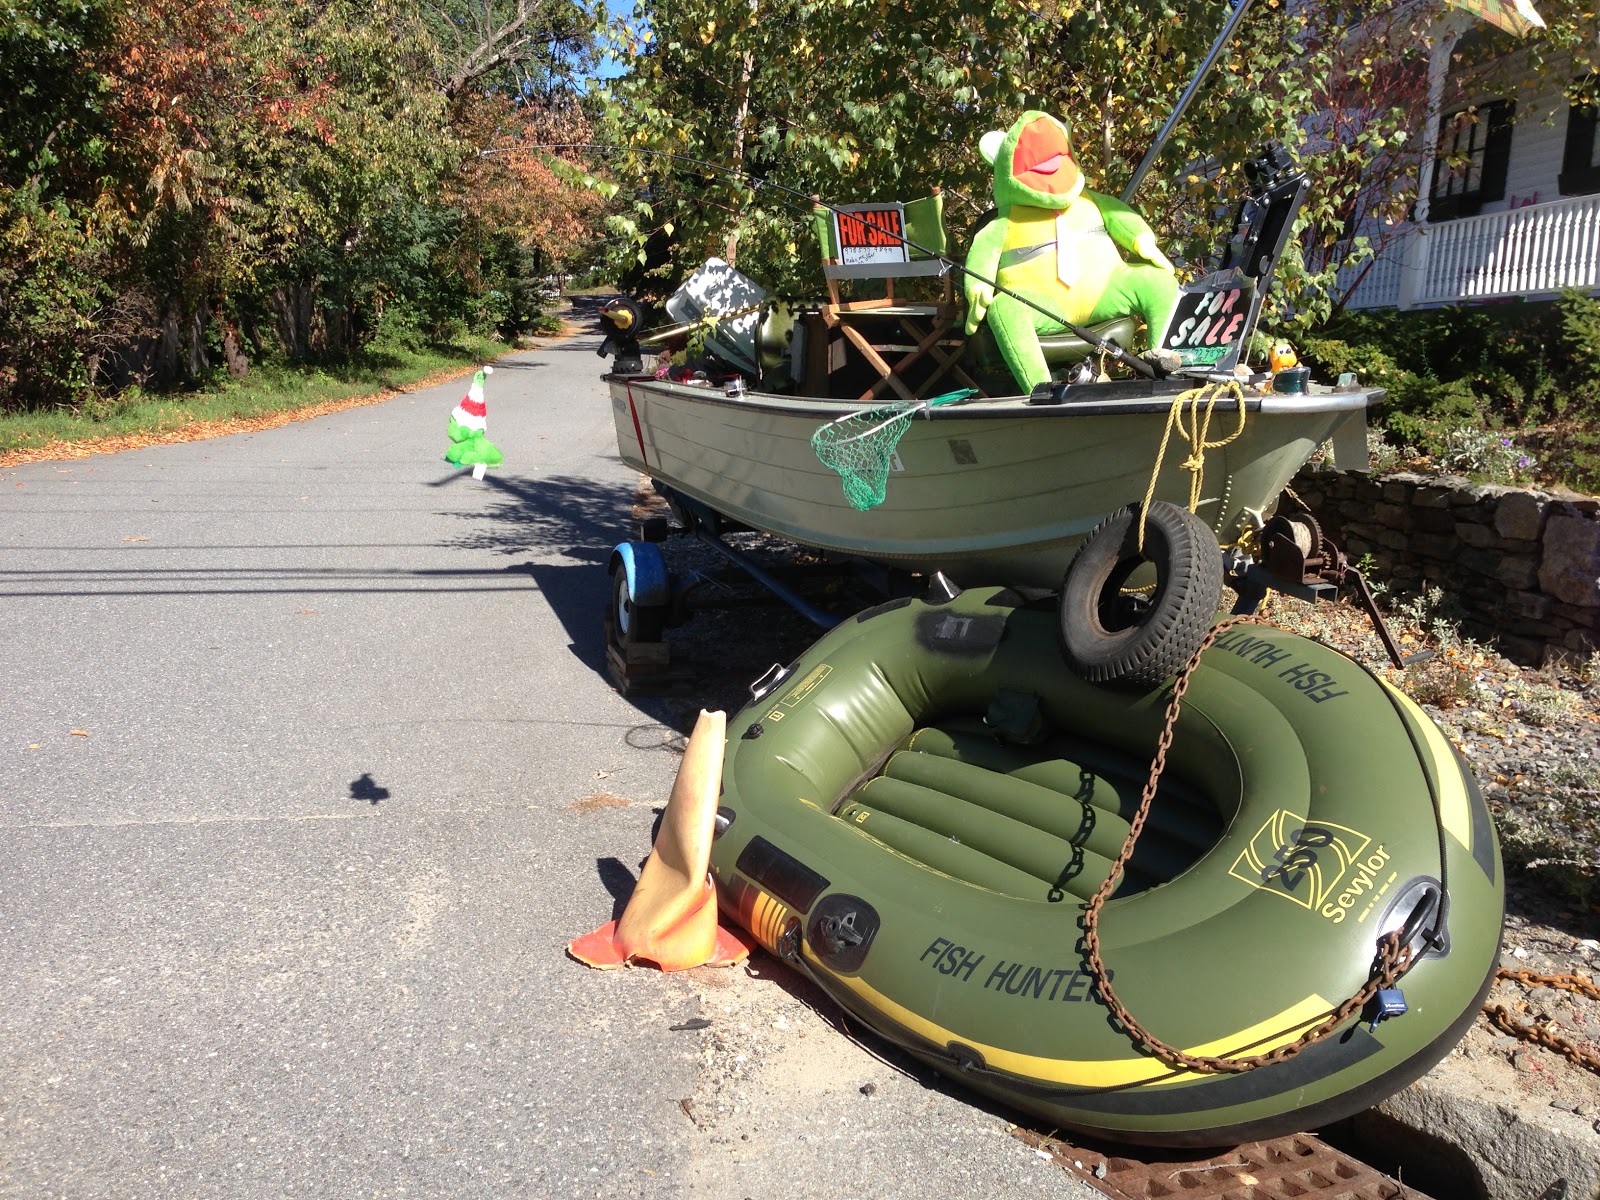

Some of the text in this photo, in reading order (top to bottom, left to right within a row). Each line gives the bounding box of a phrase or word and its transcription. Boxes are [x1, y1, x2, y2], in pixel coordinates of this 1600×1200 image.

[838, 210, 902, 246] FOR SALE
[1194, 288, 1241, 316] FOR
[1169, 313, 1244, 347] SALE
[1278, 663, 1349, 703] FISH
[1261, 827, 1334, 891] 250
[1321, 844, 1391, 924] Sevylor
[919, 937, 986, 982] FISH
